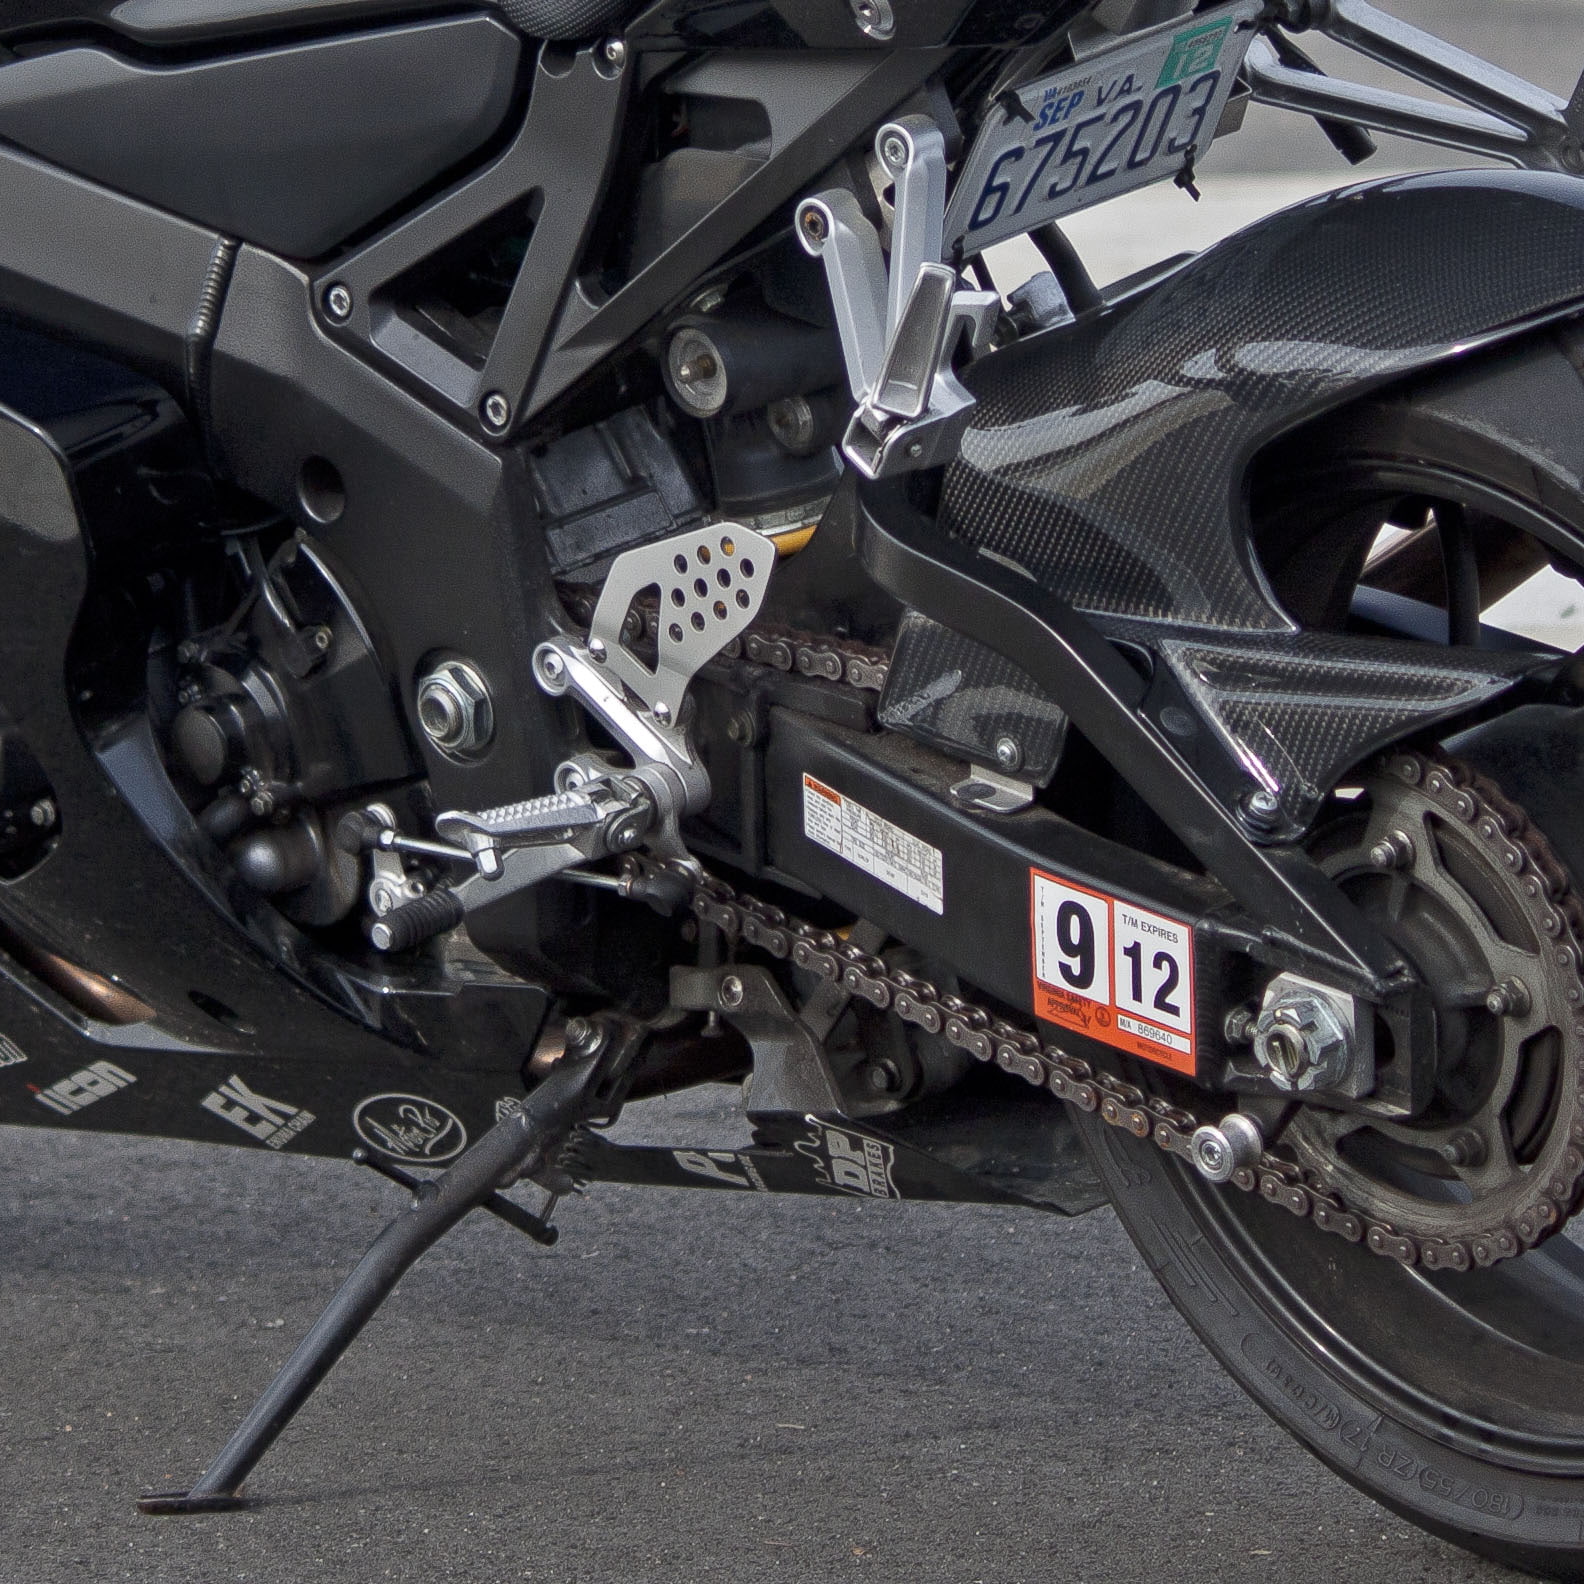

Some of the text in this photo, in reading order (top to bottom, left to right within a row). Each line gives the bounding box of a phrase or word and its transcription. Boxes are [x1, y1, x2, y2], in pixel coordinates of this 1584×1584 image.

[1033, 90, 1084, 131] SEP
[968, 69, 1221, 232] 675203
[1056, 900, 1096, 990] 9
[1122, 914, 1179, 944] T/M EXPIRES
[1123, 940, 1181, 1018] 12
[1137, 1023, 1173, 1046] 869640
[200, 1073, 299, 1141] EK
[825, 1130, 870, 1193] DP
[867, 1141, 888, 1197] BRAKES
